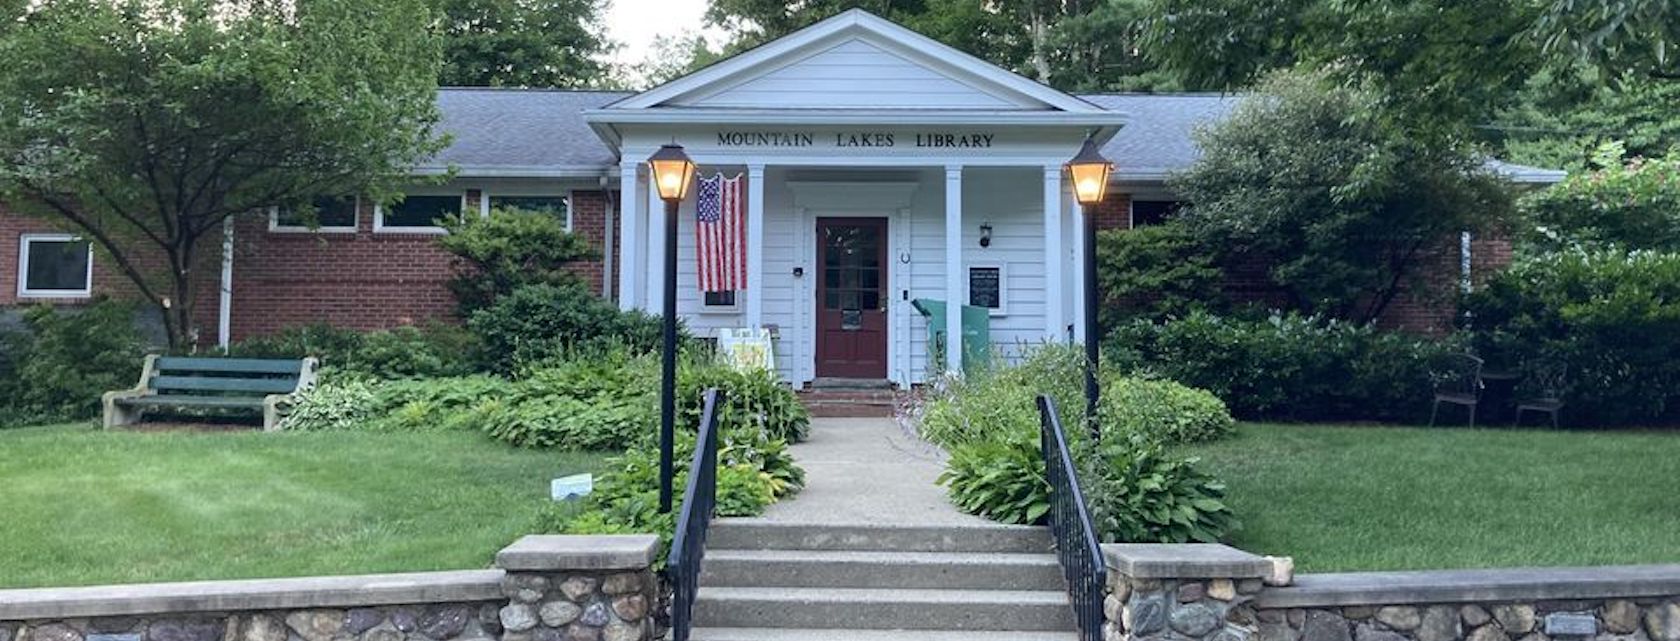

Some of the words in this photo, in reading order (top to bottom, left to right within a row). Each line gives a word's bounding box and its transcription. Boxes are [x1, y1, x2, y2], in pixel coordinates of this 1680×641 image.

[717, 132, 814, 147] MOUNTAIN
[836, 132, 895, 147] LAKES
[916, 133, 995, 148] LIBRARY
